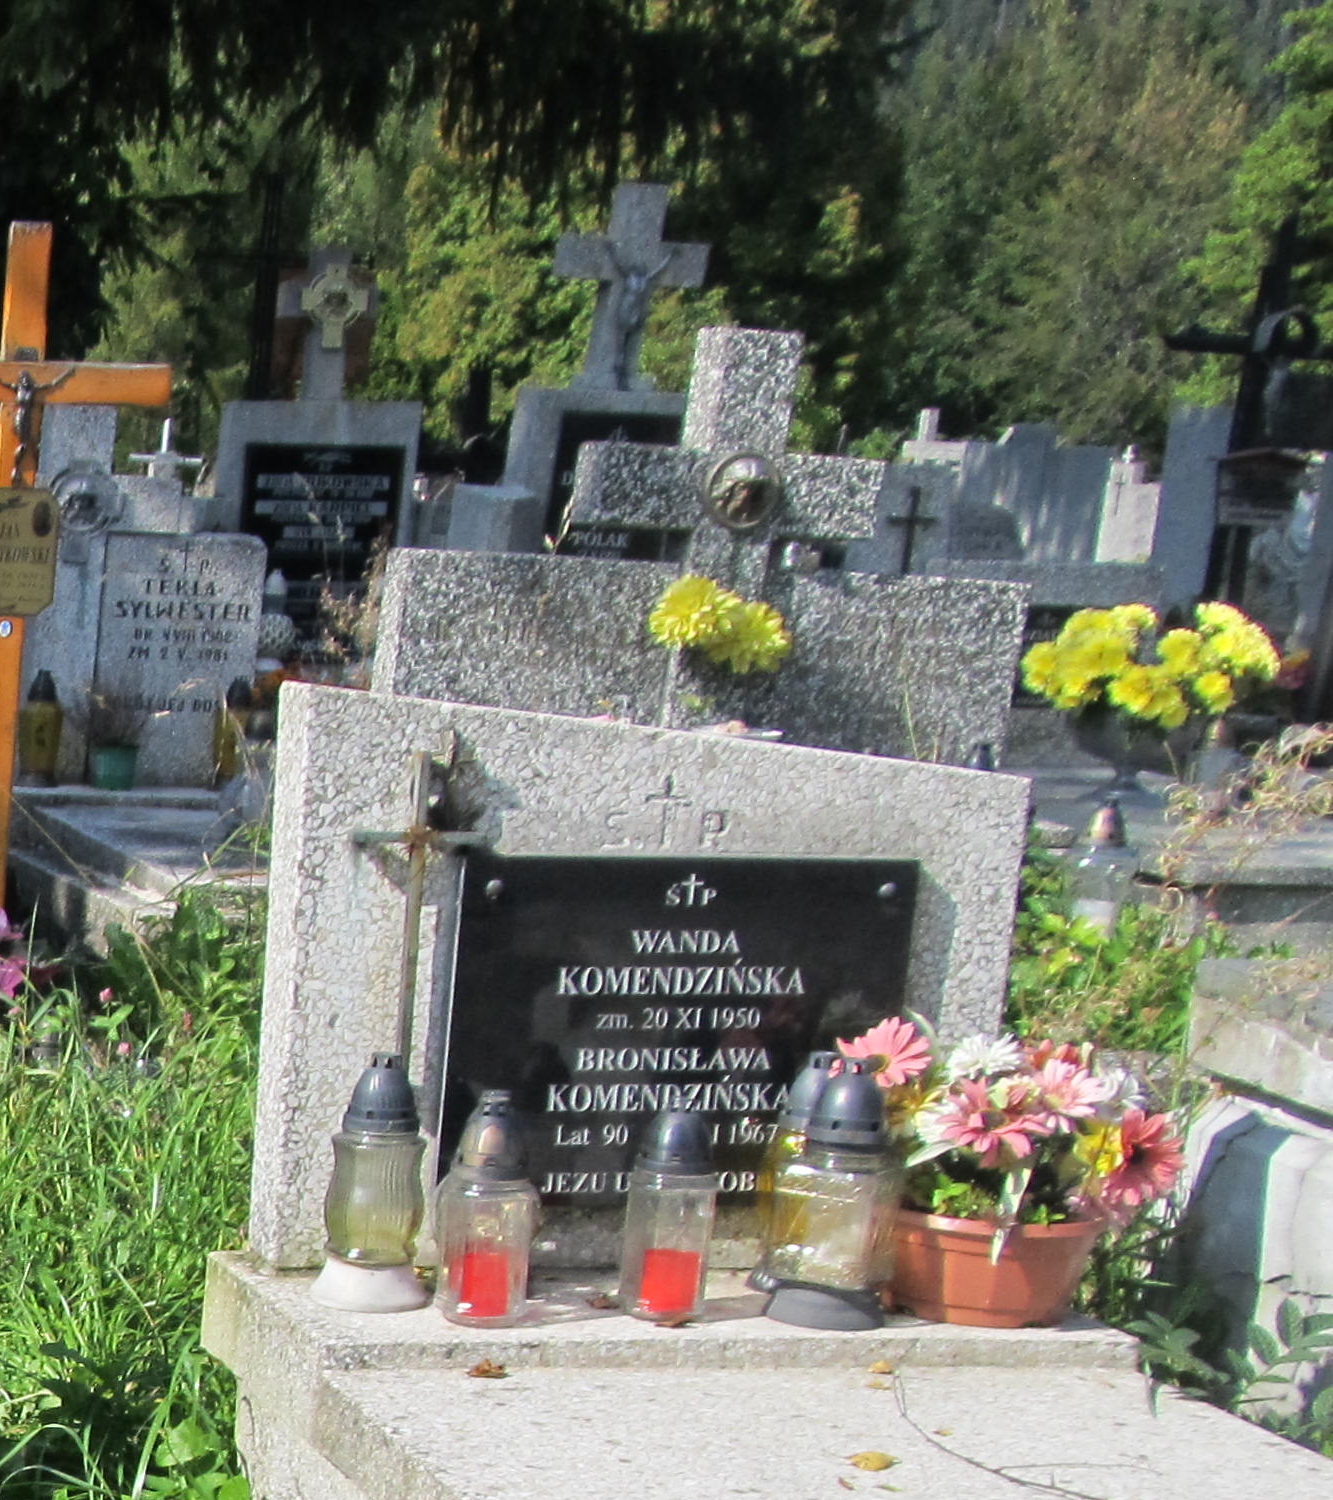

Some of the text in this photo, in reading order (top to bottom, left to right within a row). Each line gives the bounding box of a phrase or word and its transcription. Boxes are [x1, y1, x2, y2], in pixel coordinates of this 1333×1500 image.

[143, 578, 217, 597] TEKLA
[114, 600, 252, 622] SYLWESTER
[630, 928, 742, 954] WANDA
[555, 957, 806, 997] KOMENDZIŃSKA
[594, 1006, 761, 1031] zm. 20 XI 1950
[574, 1046, 773, 1074] BRONISŁAWA
[554, 1126, 591, 1151] Lat
[601, 1125, 630, 1150] 90
[728, 1124, 780, 1150] 1967
[540, 1171, 607, 1194] JEZU
